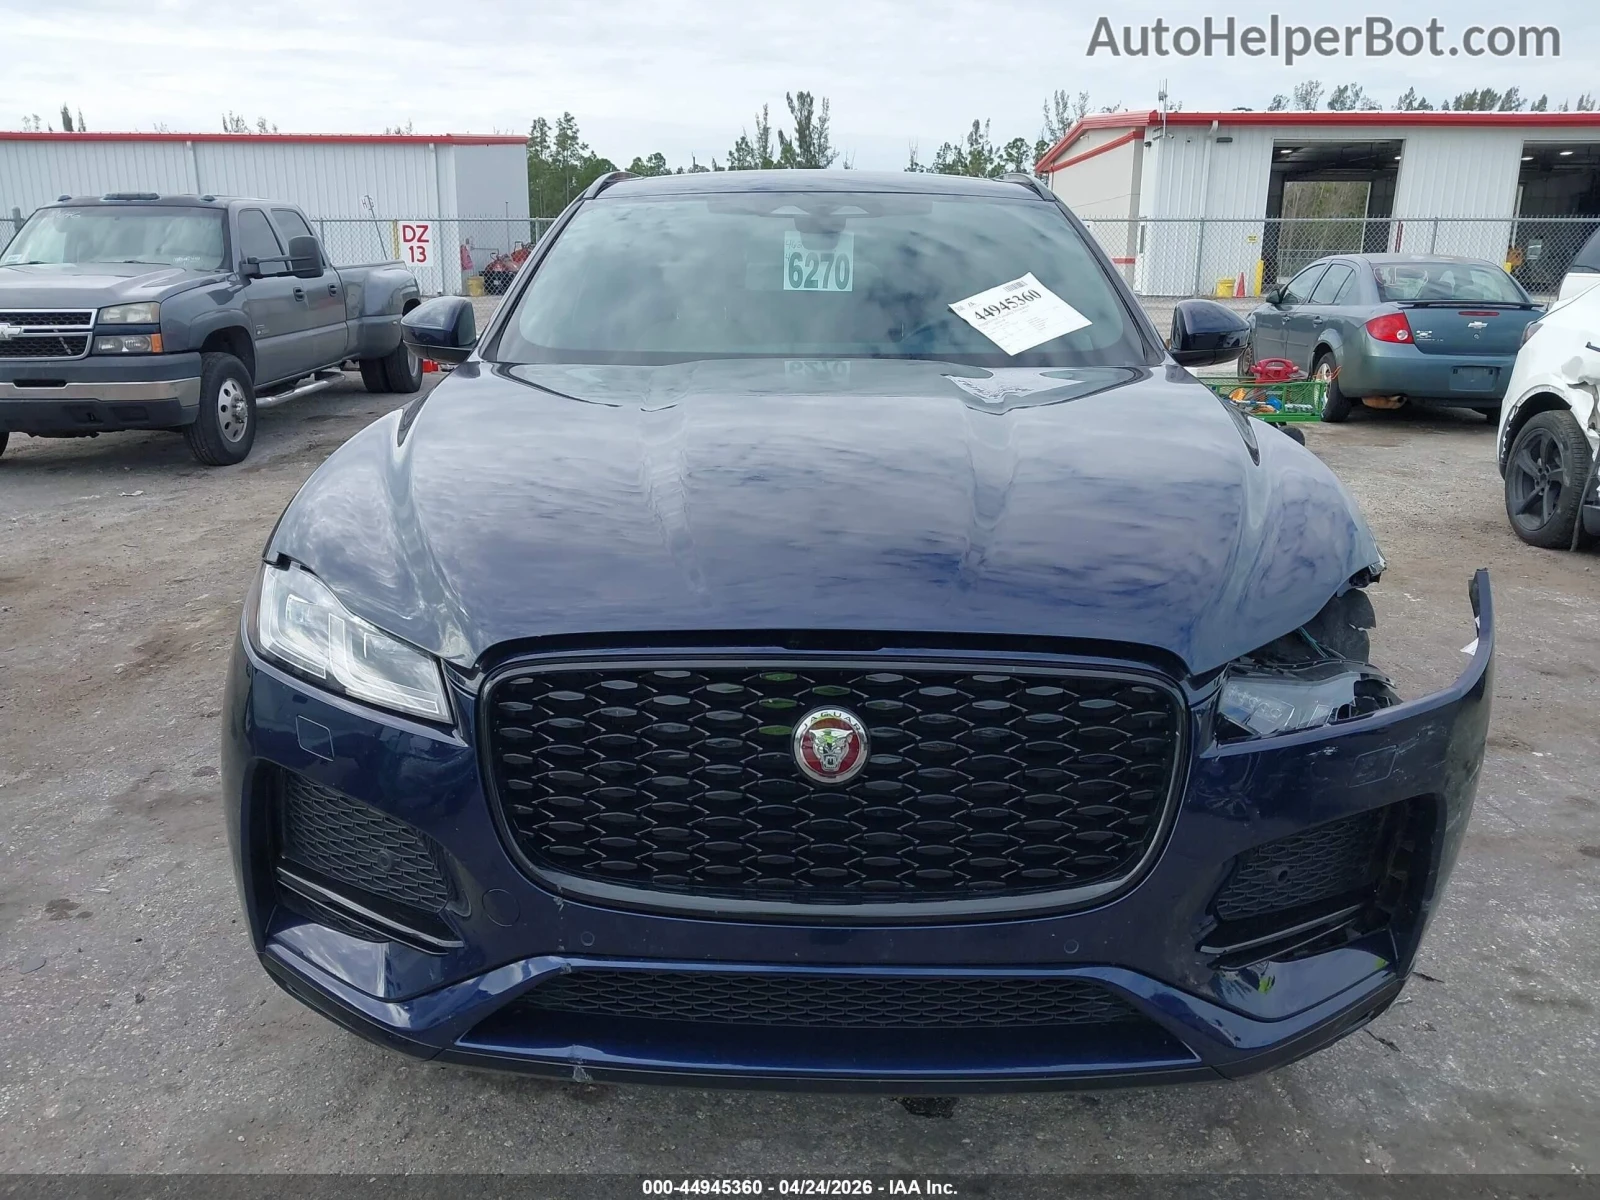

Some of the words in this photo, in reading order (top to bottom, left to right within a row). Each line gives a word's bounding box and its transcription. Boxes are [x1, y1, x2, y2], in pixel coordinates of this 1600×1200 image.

[402, 224, 430, 243] DZ
[408, 245, 427, 263] 13
[788, 251, 850, 290] 6270
[974, 289, 1042, 320] 44945360
[801, 711, 862, 731] JAGUAR
